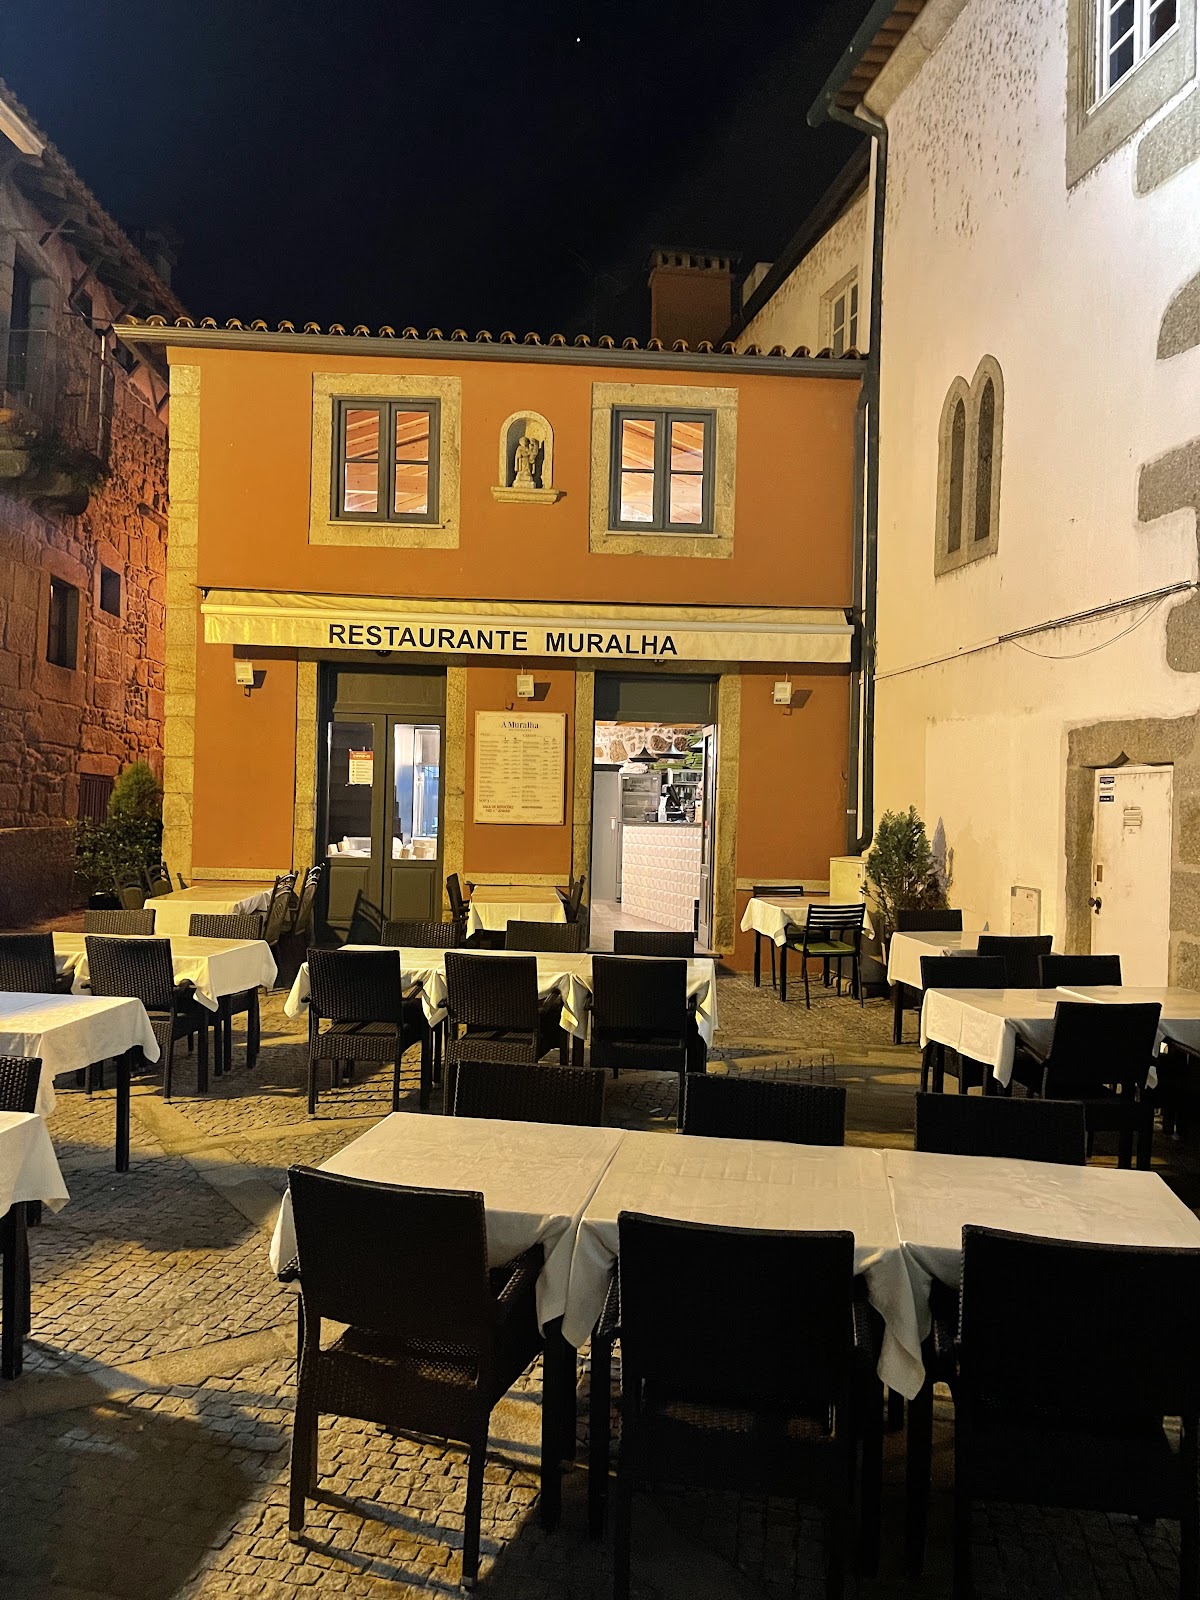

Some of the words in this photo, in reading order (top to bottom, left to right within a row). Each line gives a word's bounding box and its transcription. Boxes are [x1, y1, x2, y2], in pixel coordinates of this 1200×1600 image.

[329, 623, 528, 651] RESTAURANTE
[546, 632, 678, 655] MURALHA
[508, 721, 539, 729] Muralha
